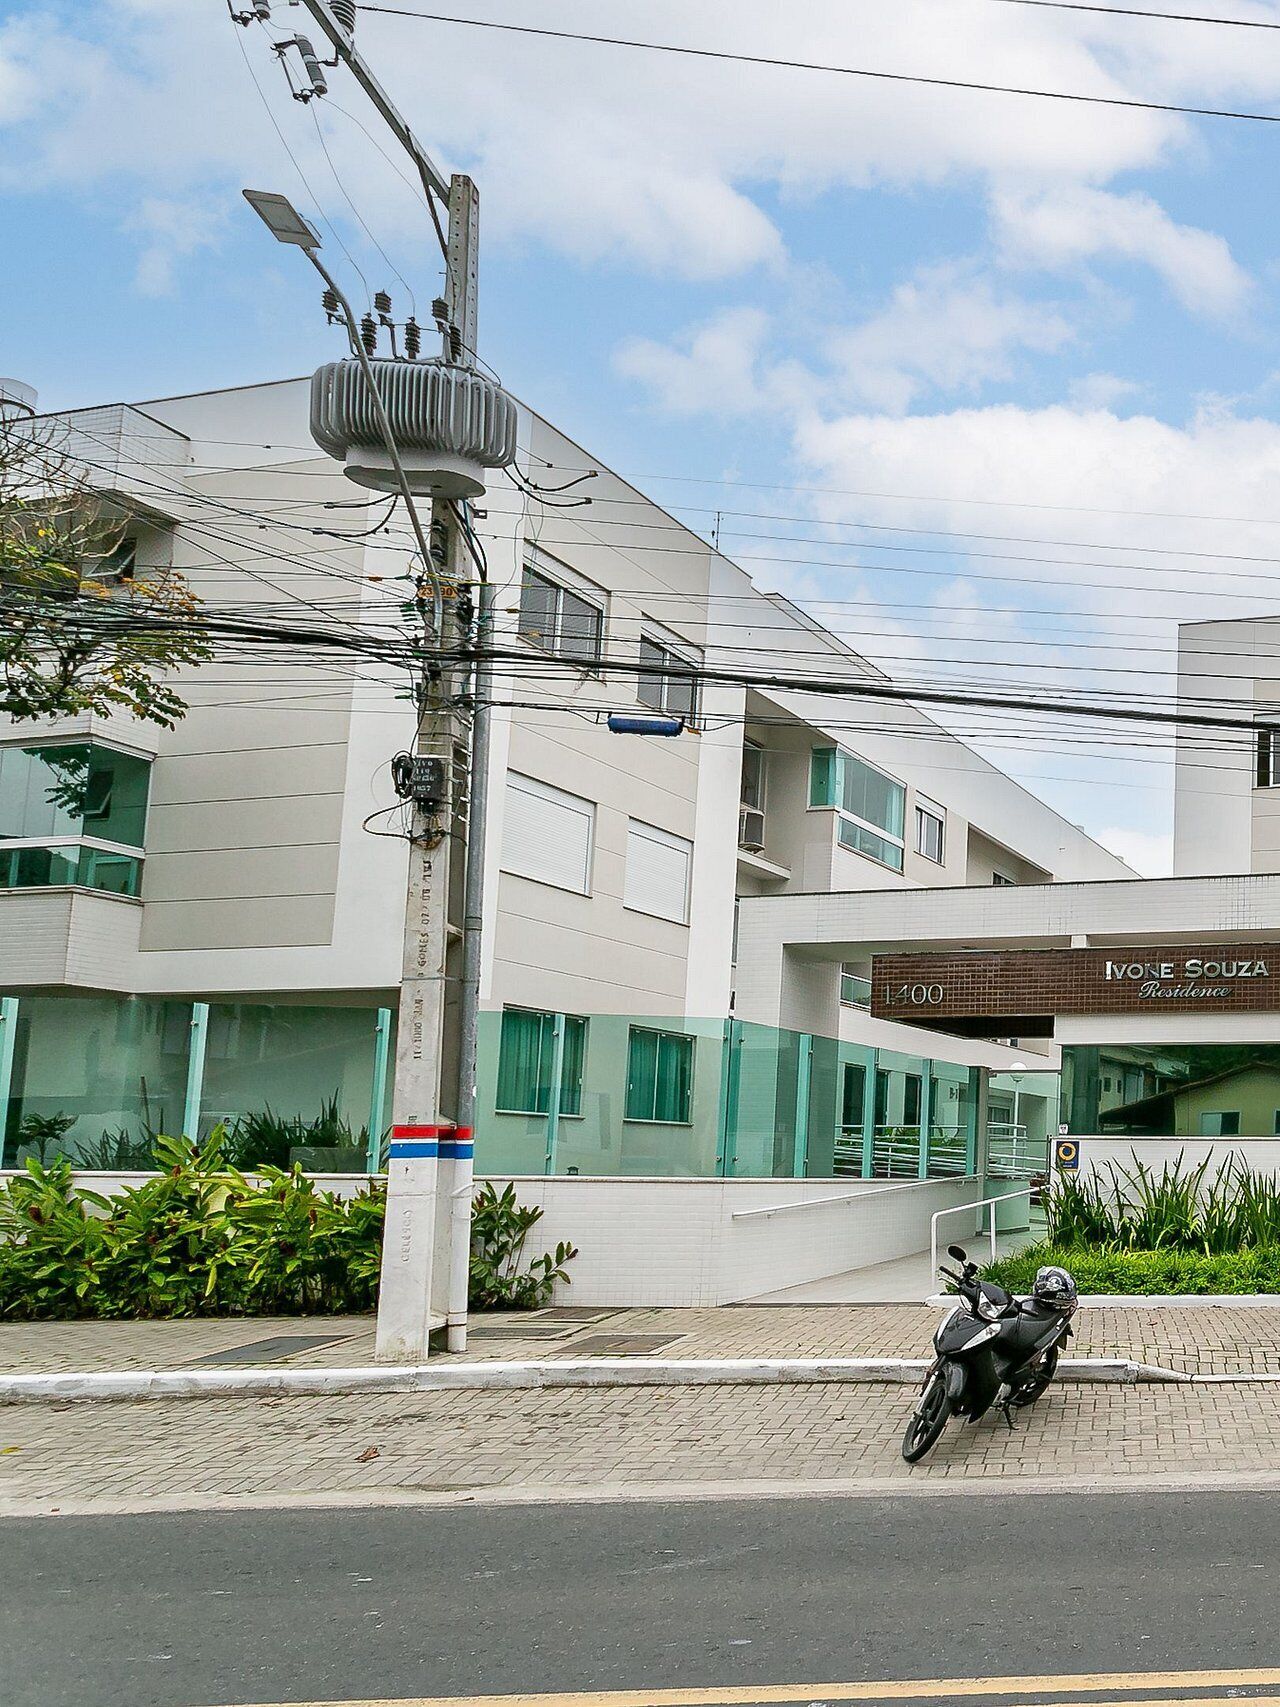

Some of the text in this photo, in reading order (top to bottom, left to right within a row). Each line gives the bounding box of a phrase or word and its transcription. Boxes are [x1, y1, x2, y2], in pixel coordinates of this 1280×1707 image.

[1104, 958, 1270, 980] IVONE SOUZA
[1138, 980, 1233, 999] Residence
